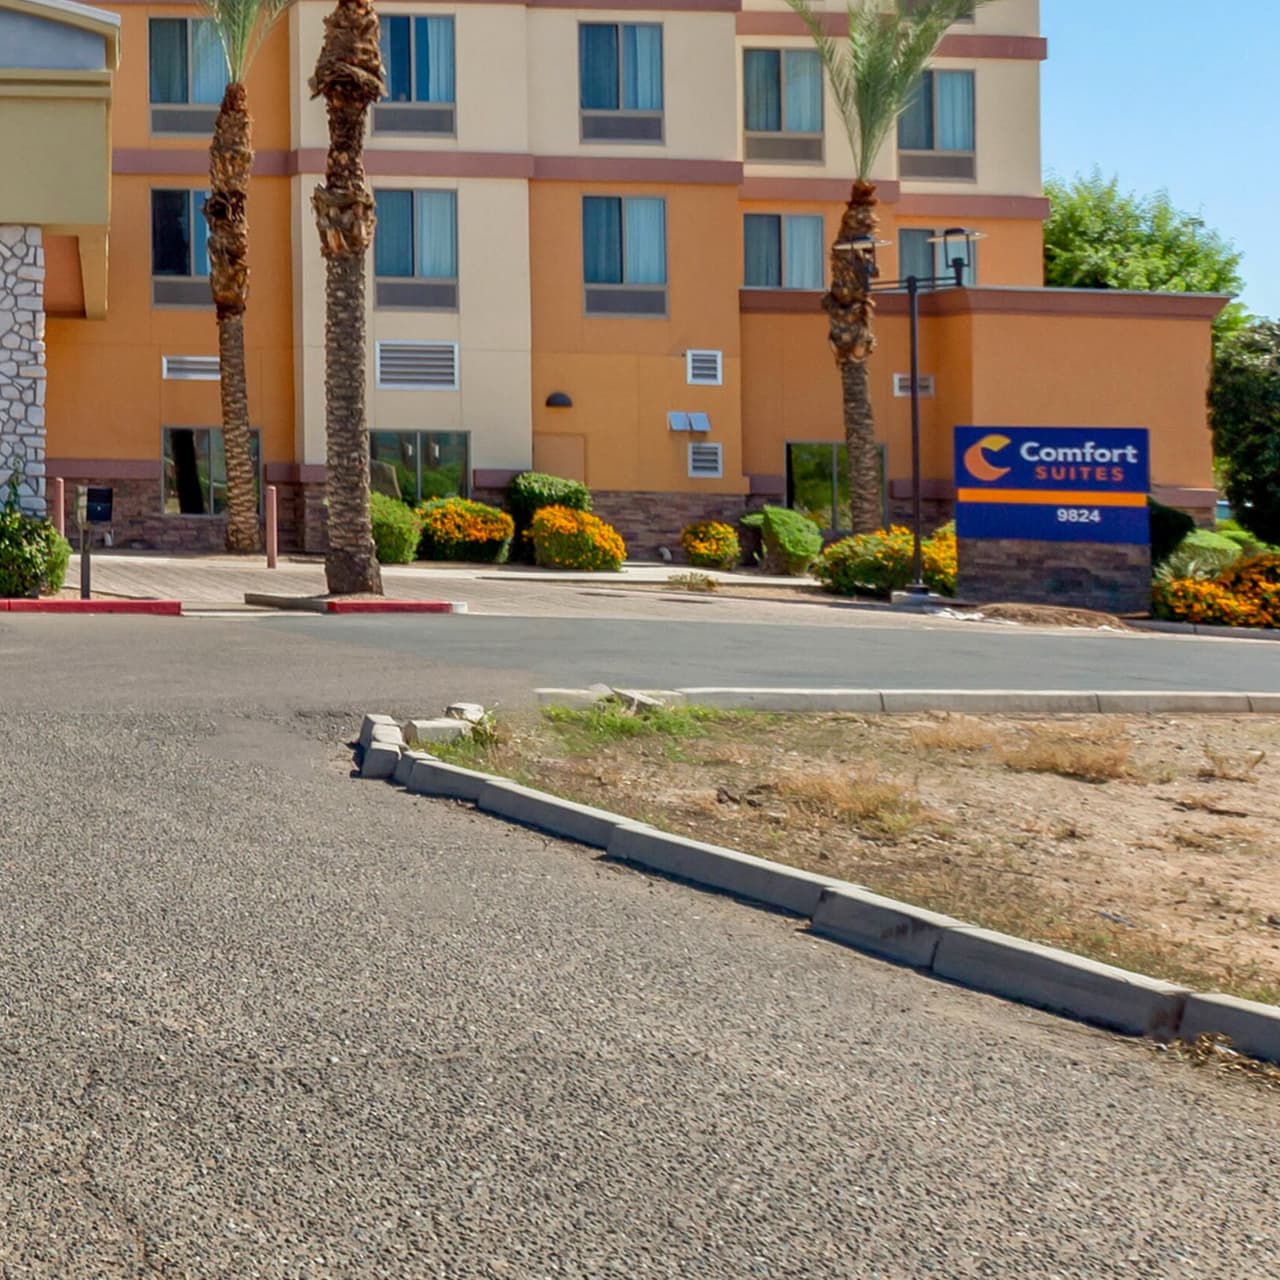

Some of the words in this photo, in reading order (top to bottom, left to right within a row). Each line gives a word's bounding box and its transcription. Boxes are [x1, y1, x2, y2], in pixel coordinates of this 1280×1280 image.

[1020, 441, 1138, 463] Comfort
[1035, 466, 1124, 482] SUITES
[1057, 508, 1101, 523] 9824
